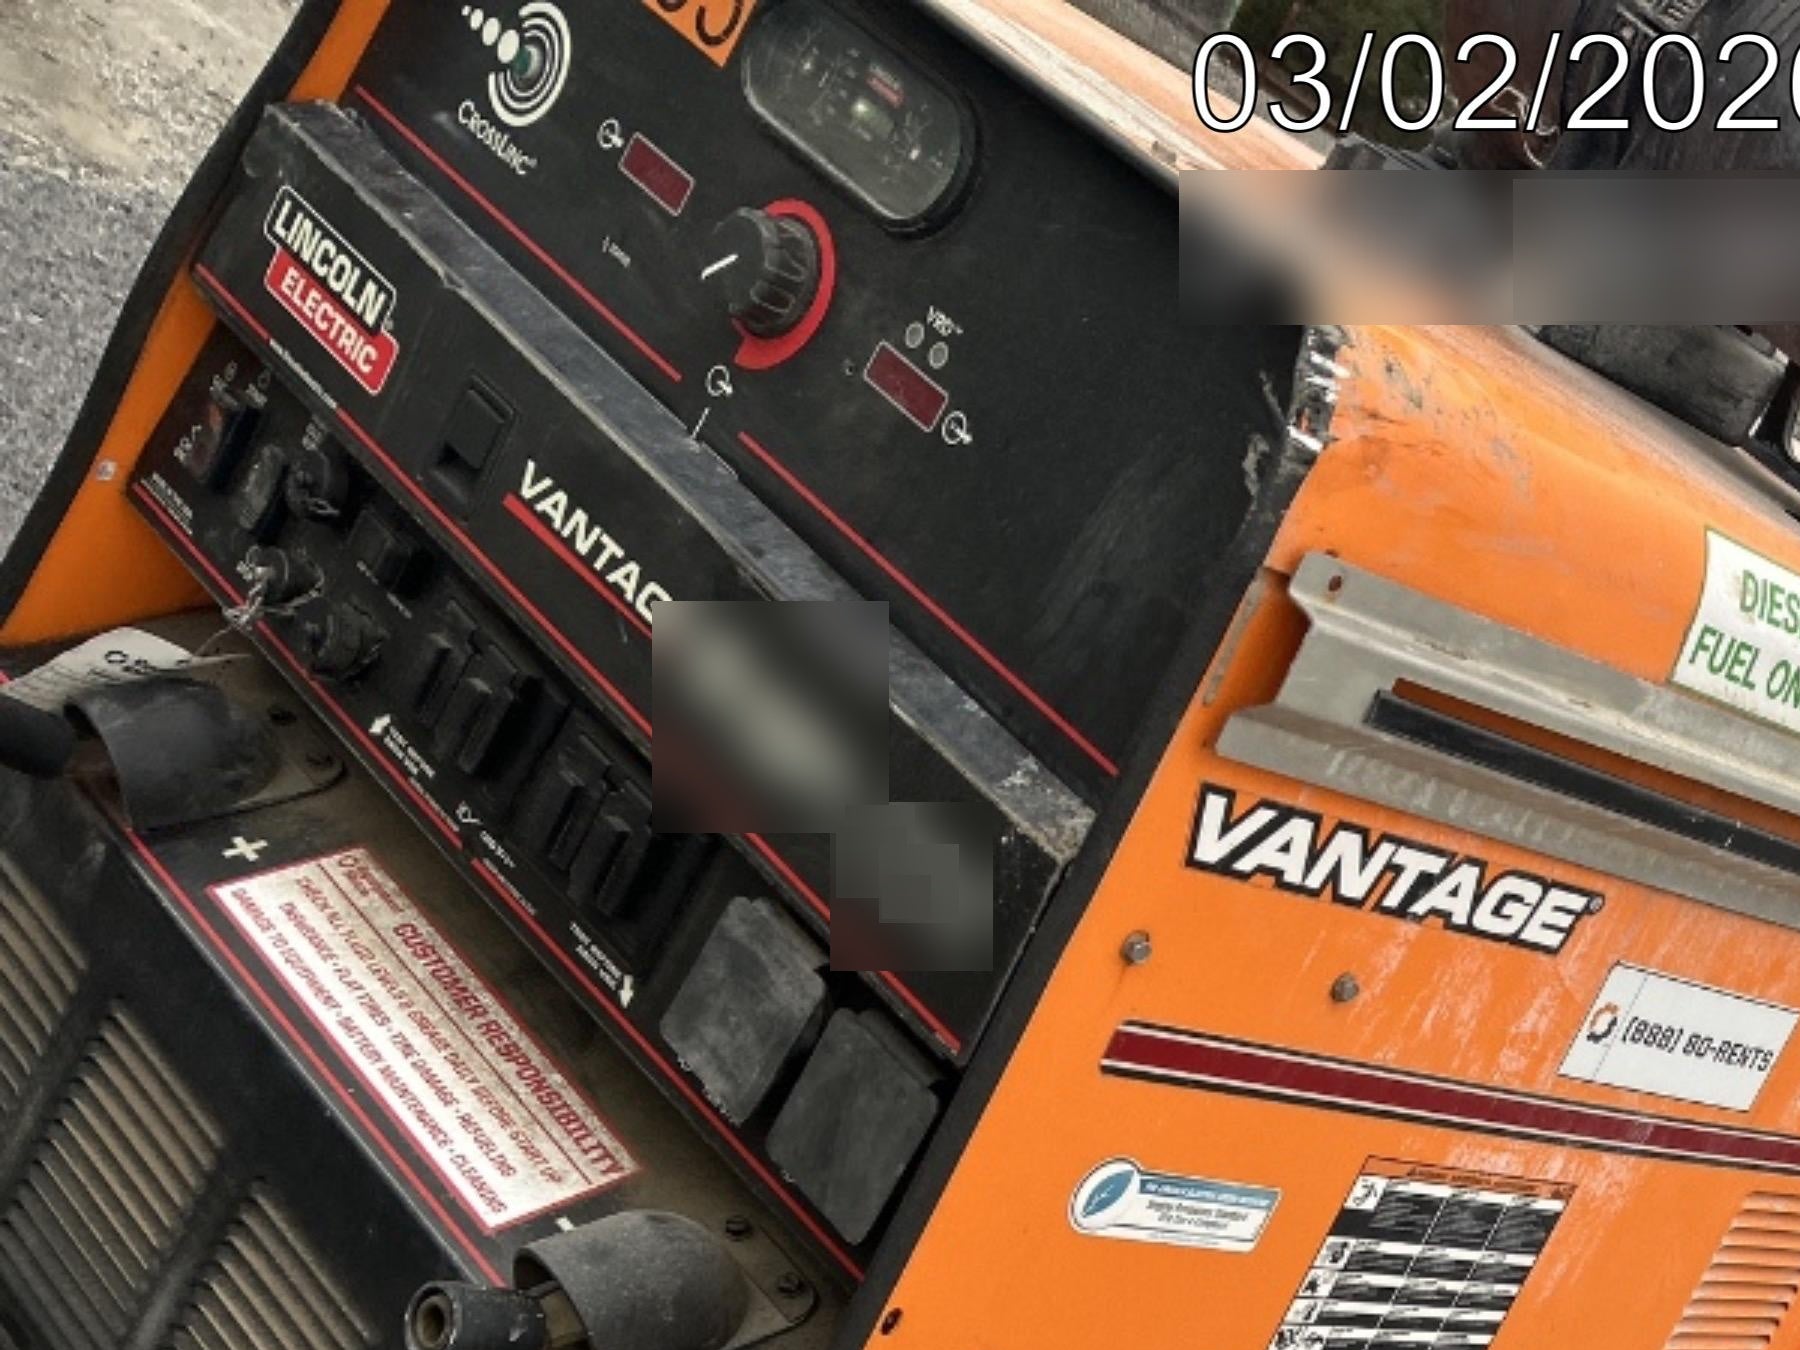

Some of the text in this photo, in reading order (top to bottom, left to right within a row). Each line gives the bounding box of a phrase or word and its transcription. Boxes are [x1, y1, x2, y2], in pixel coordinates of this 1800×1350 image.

[274, 199, 387, 327] LINCOLN
[280, 266, 378, 374] ELECTRIC
[520, 459, 673, 624] VANTAG
[1688, 624, 1756, 691] FUEL
[1188, 784, 1594, 954] VANTAGE
[388, 921, 491, 1022] CUSTOMER
[472, 1017, 626, 1178] RESPONSIBILITY
[1621, 1015, 1683, 1054] (888)
[507, 1128, 549, 1167] START
